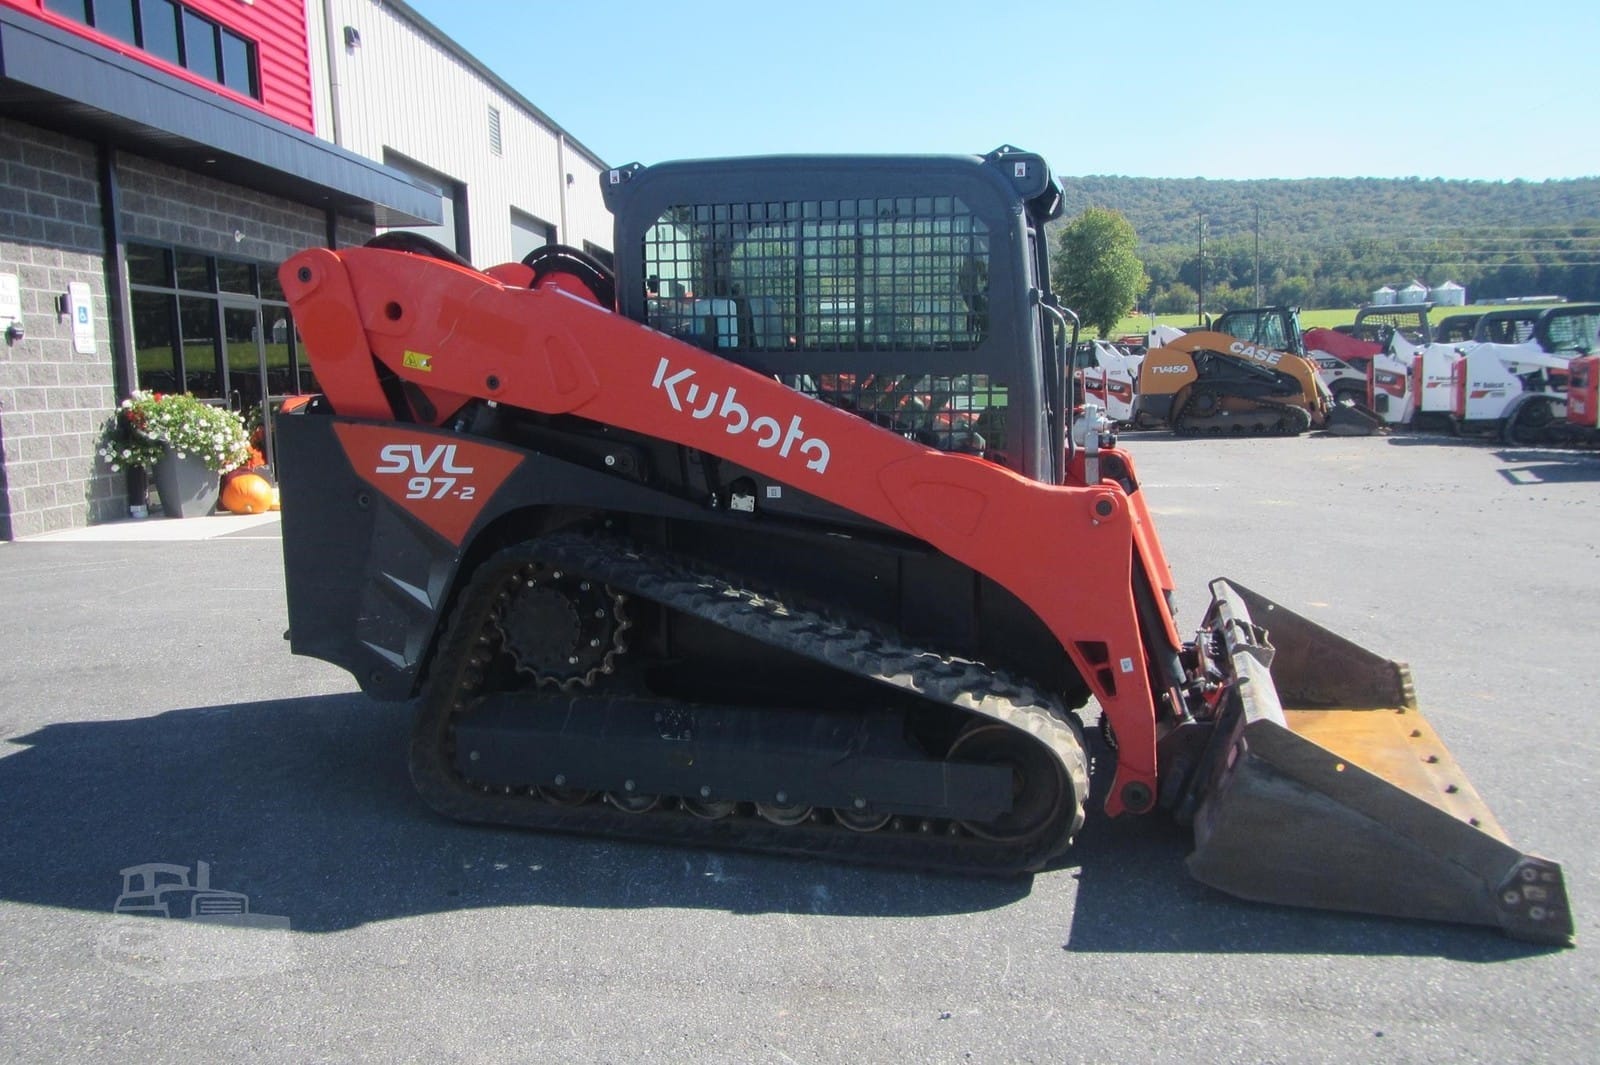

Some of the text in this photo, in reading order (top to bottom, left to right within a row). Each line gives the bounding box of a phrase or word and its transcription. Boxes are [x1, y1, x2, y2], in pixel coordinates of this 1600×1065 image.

[1230, 341, 1282, 365] CASE
[1151, 365, 1188, 374] TV450
[651, 357, 830, 474] Kubota
[376, 445, 474, 473] SVL
[406, 477, 476, 500] 97-2
